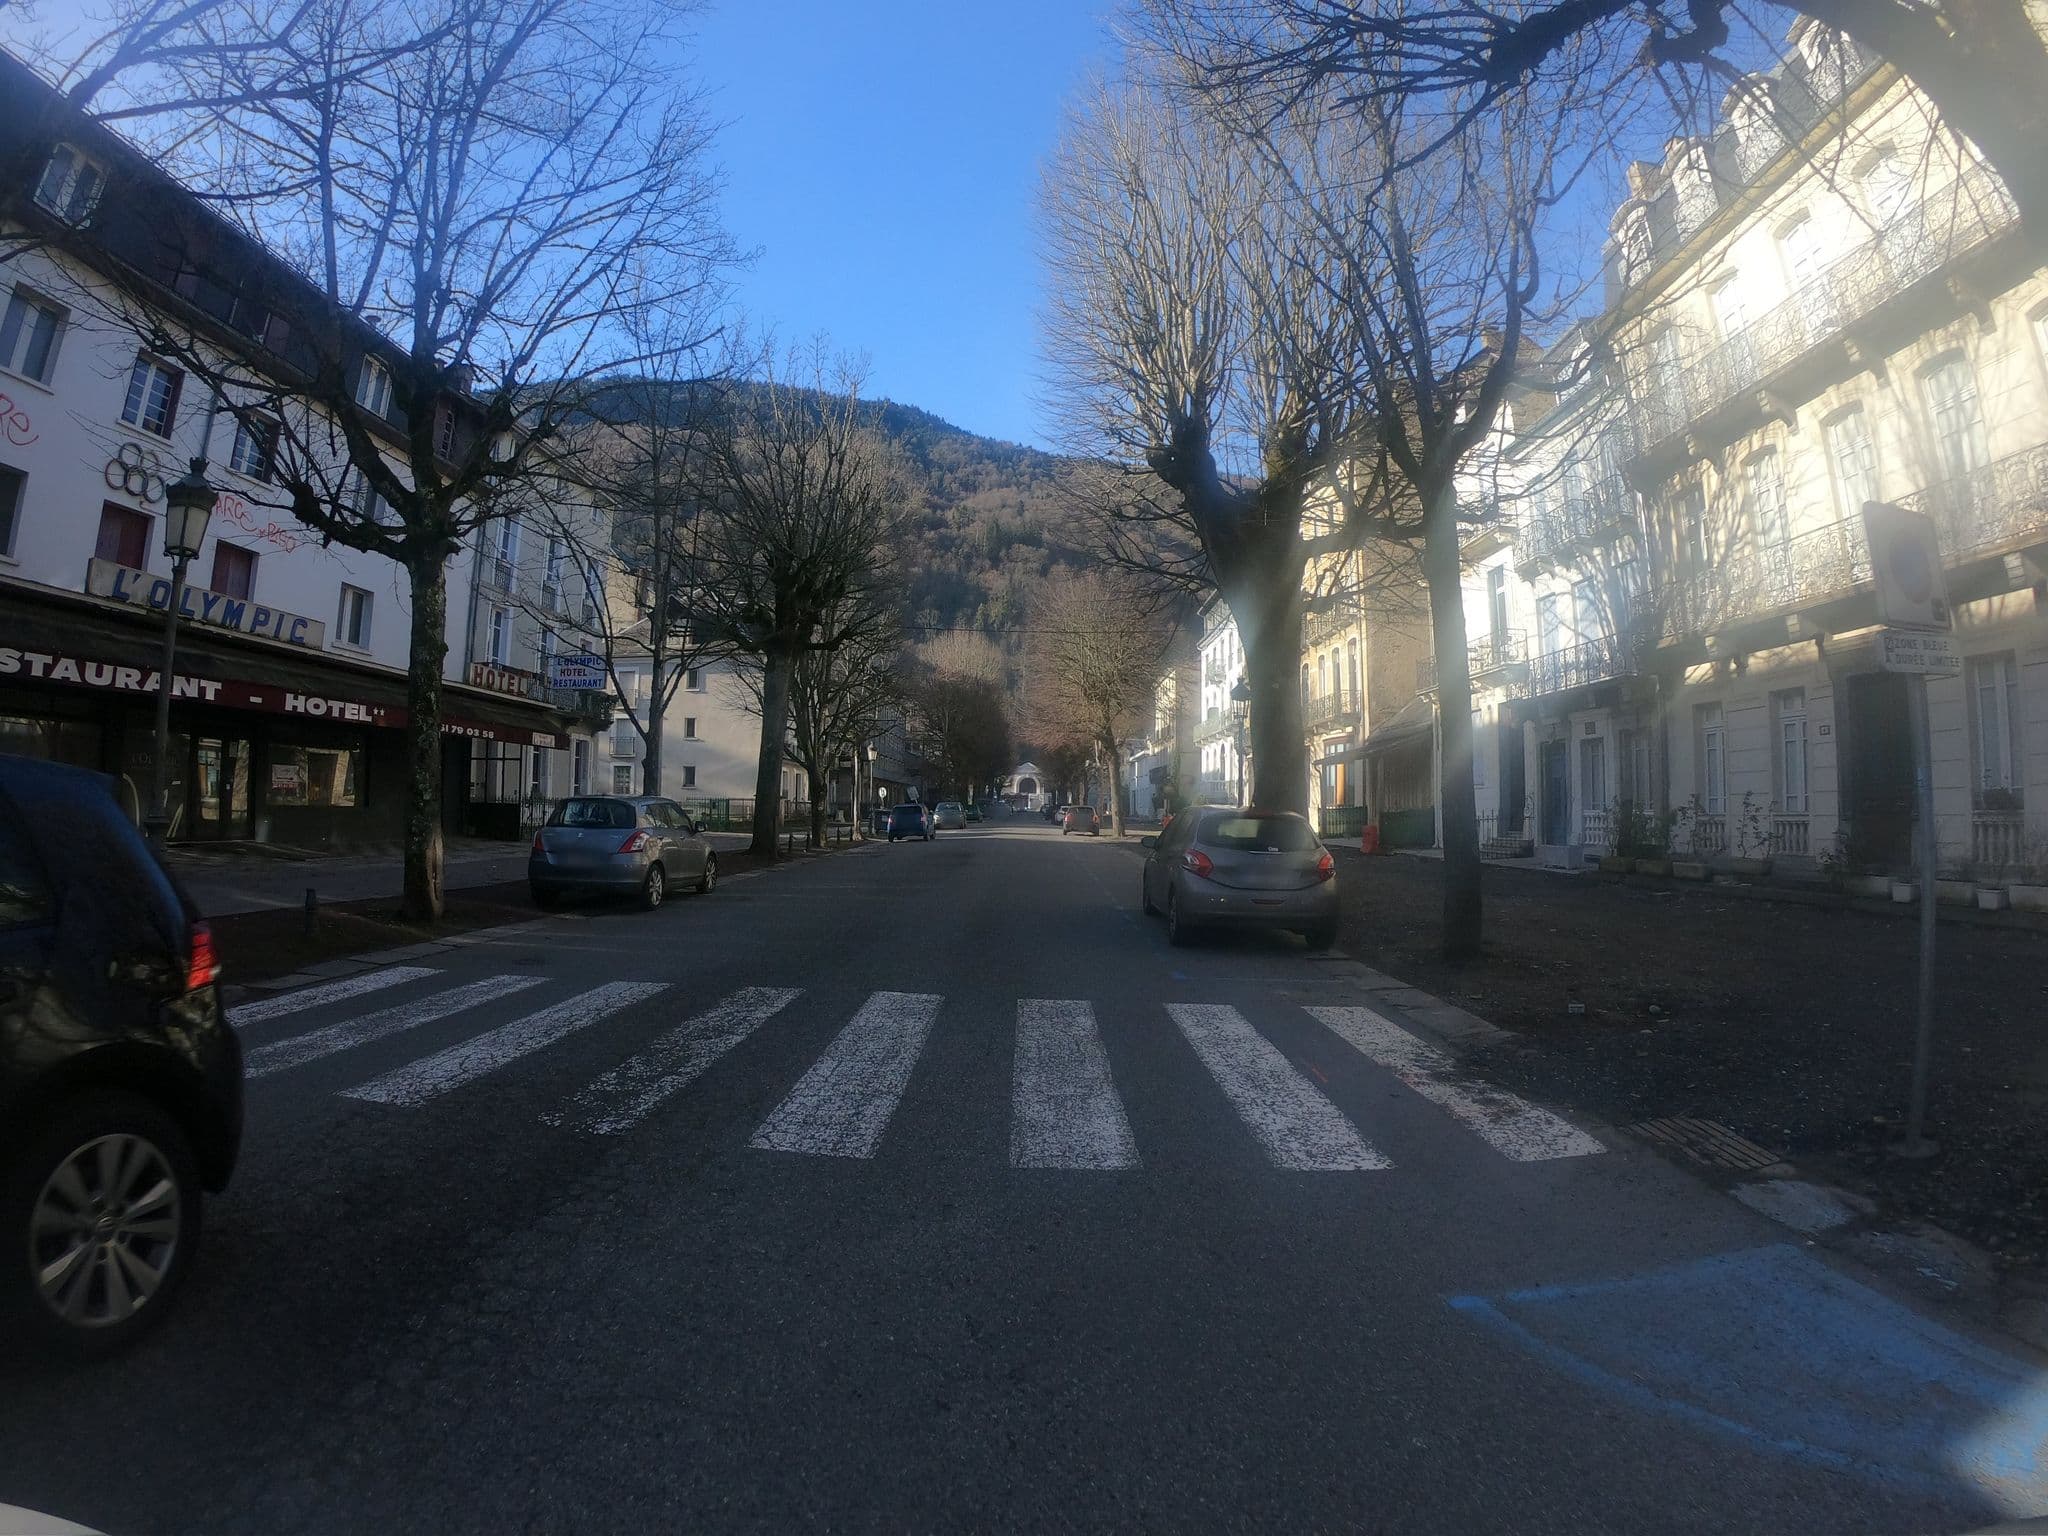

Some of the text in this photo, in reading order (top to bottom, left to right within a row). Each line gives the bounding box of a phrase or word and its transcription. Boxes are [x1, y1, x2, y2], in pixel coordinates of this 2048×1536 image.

[112, 568, 309, 645] L'OLYMPIC
[560, 668, 588, 677] HOTEL
[552, 679, 603, 689] RESTAURANT
